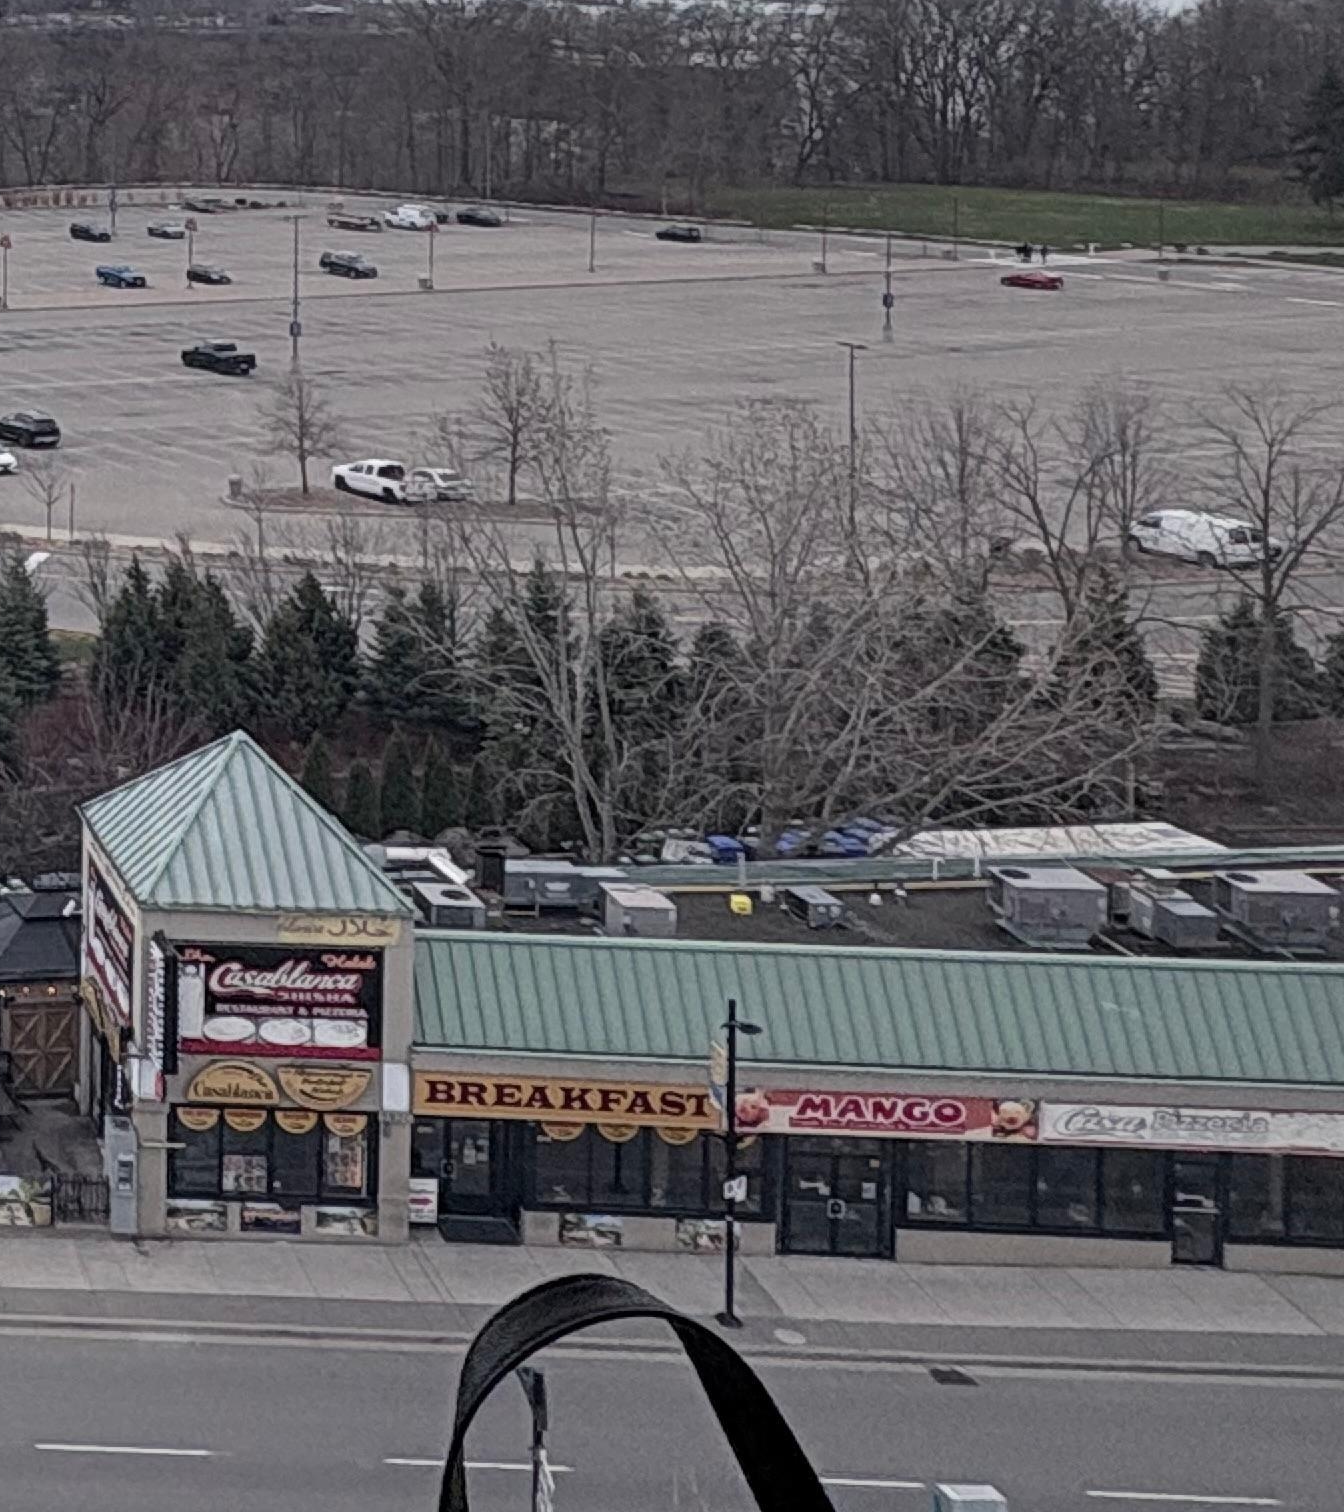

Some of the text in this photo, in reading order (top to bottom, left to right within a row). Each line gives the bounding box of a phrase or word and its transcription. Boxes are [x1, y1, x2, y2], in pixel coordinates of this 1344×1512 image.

[209, 958, 361, 997] Casablanca
[425, 1080, 710, 1118] BREAKFAST
[794, 1094, 967, 1127] MANGO
